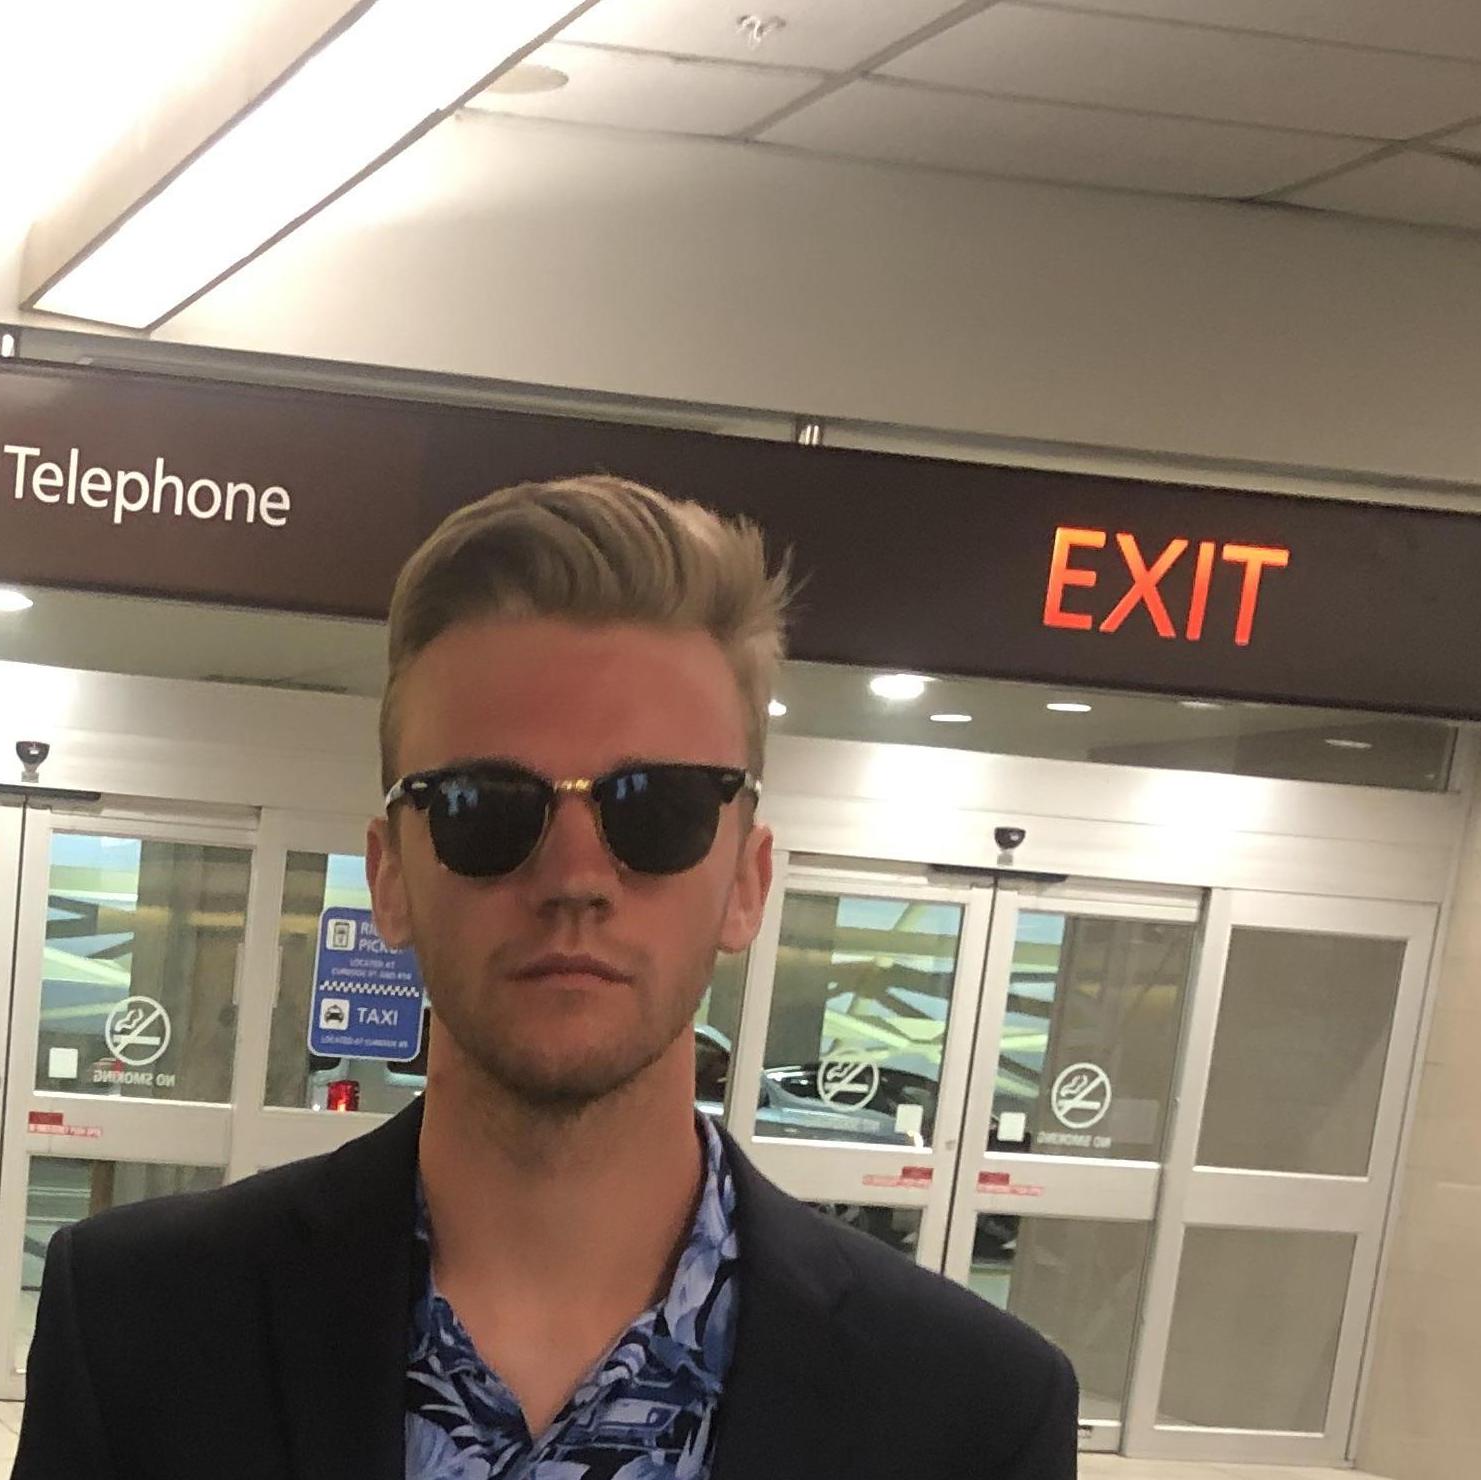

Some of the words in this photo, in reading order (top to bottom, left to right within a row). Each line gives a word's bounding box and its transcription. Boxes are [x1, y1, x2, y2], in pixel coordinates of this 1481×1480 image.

[3, 444, 291, 527] Telephone
[1043, 526, 1290, 647] EXIT
[356, 1006, 399, 1027] TAXI
